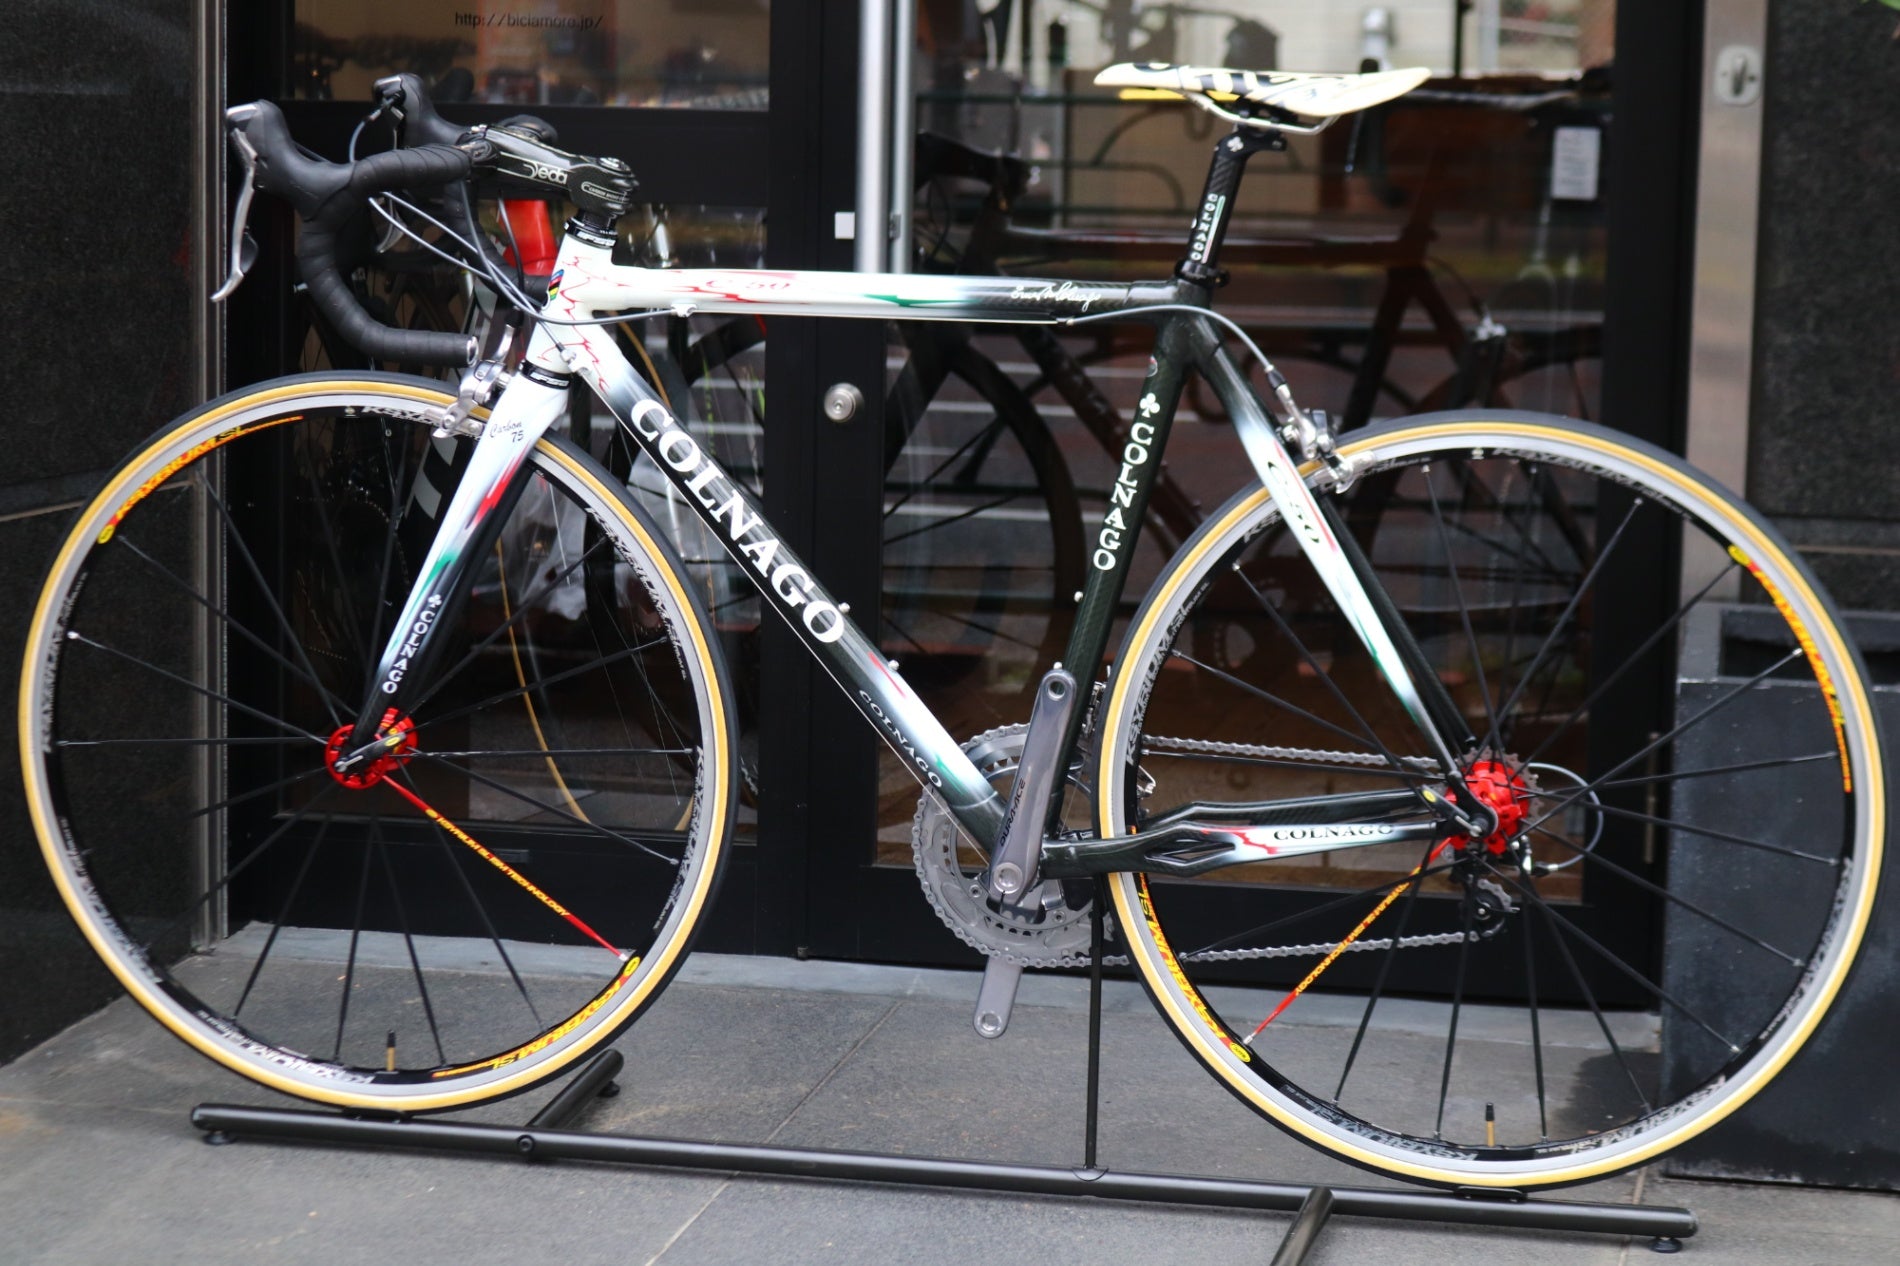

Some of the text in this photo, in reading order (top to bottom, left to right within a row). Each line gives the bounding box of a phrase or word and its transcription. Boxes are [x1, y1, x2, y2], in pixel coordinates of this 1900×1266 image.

[1190, 193, 1218, 261] COLNAGO
[511, 430, 524, 443] 75
[631, 399, 844, 643] COLNAGO
[1093, 422, 1154, 570] COLNAGO
[382, 610, 435, 694] COLNAGO
[1124, 628, 1176, 765] KSYRIUM
[859, 690, 942, 788] COLNAGO
[1000, 778, 1026, 847] DURA-ACE
[1273, 824, 1394, 840] COLNAGO
[506, 867, 570, 917] TECHNOLOGY
[1146, 916, 1228, 1044] KSYRIUM
[1291, 938, 1350, 996] TECHNOLOGY
[516, 978, 622, 1058] KSYRIUM
